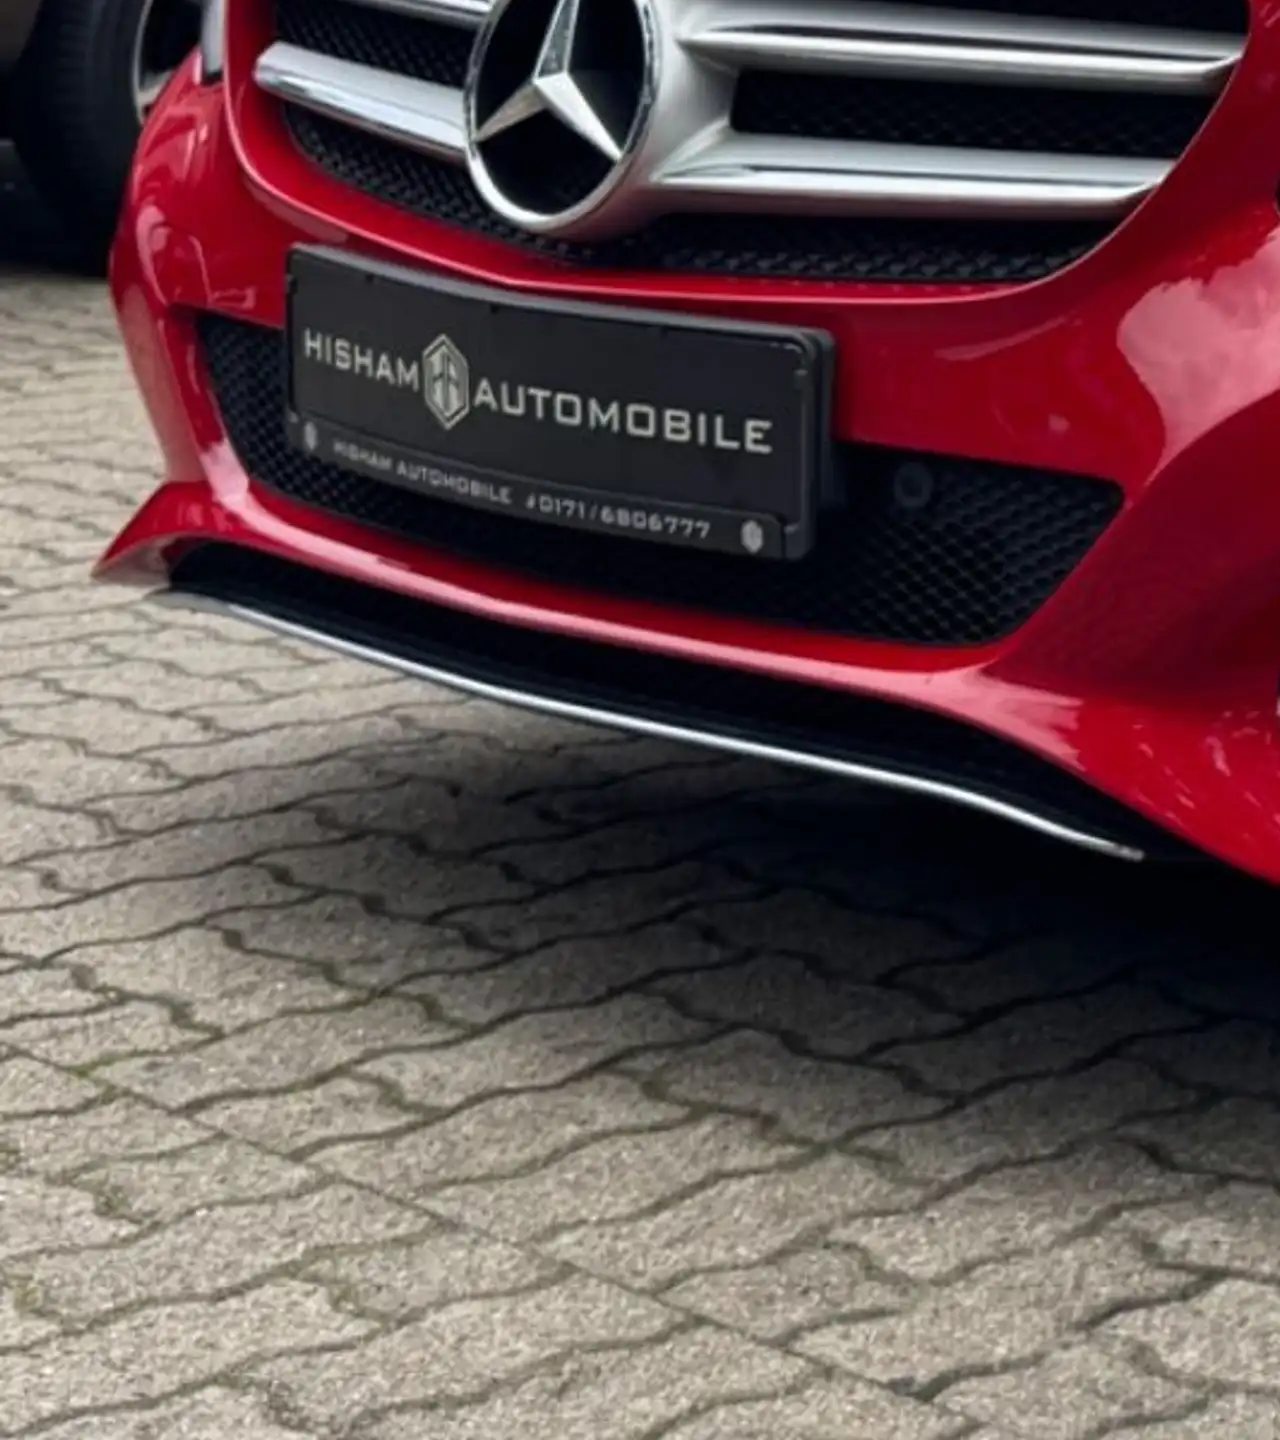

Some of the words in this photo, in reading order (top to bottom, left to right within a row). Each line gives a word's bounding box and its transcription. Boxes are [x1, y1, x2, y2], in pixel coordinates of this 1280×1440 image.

[304, 328, 420, 392] HISHAM
[474, 377, 772, 453] AUTOMOBILE
[334, 440, 392, 471] HISHAM
[396, 461, 512, 504] AUTOMOBILE
